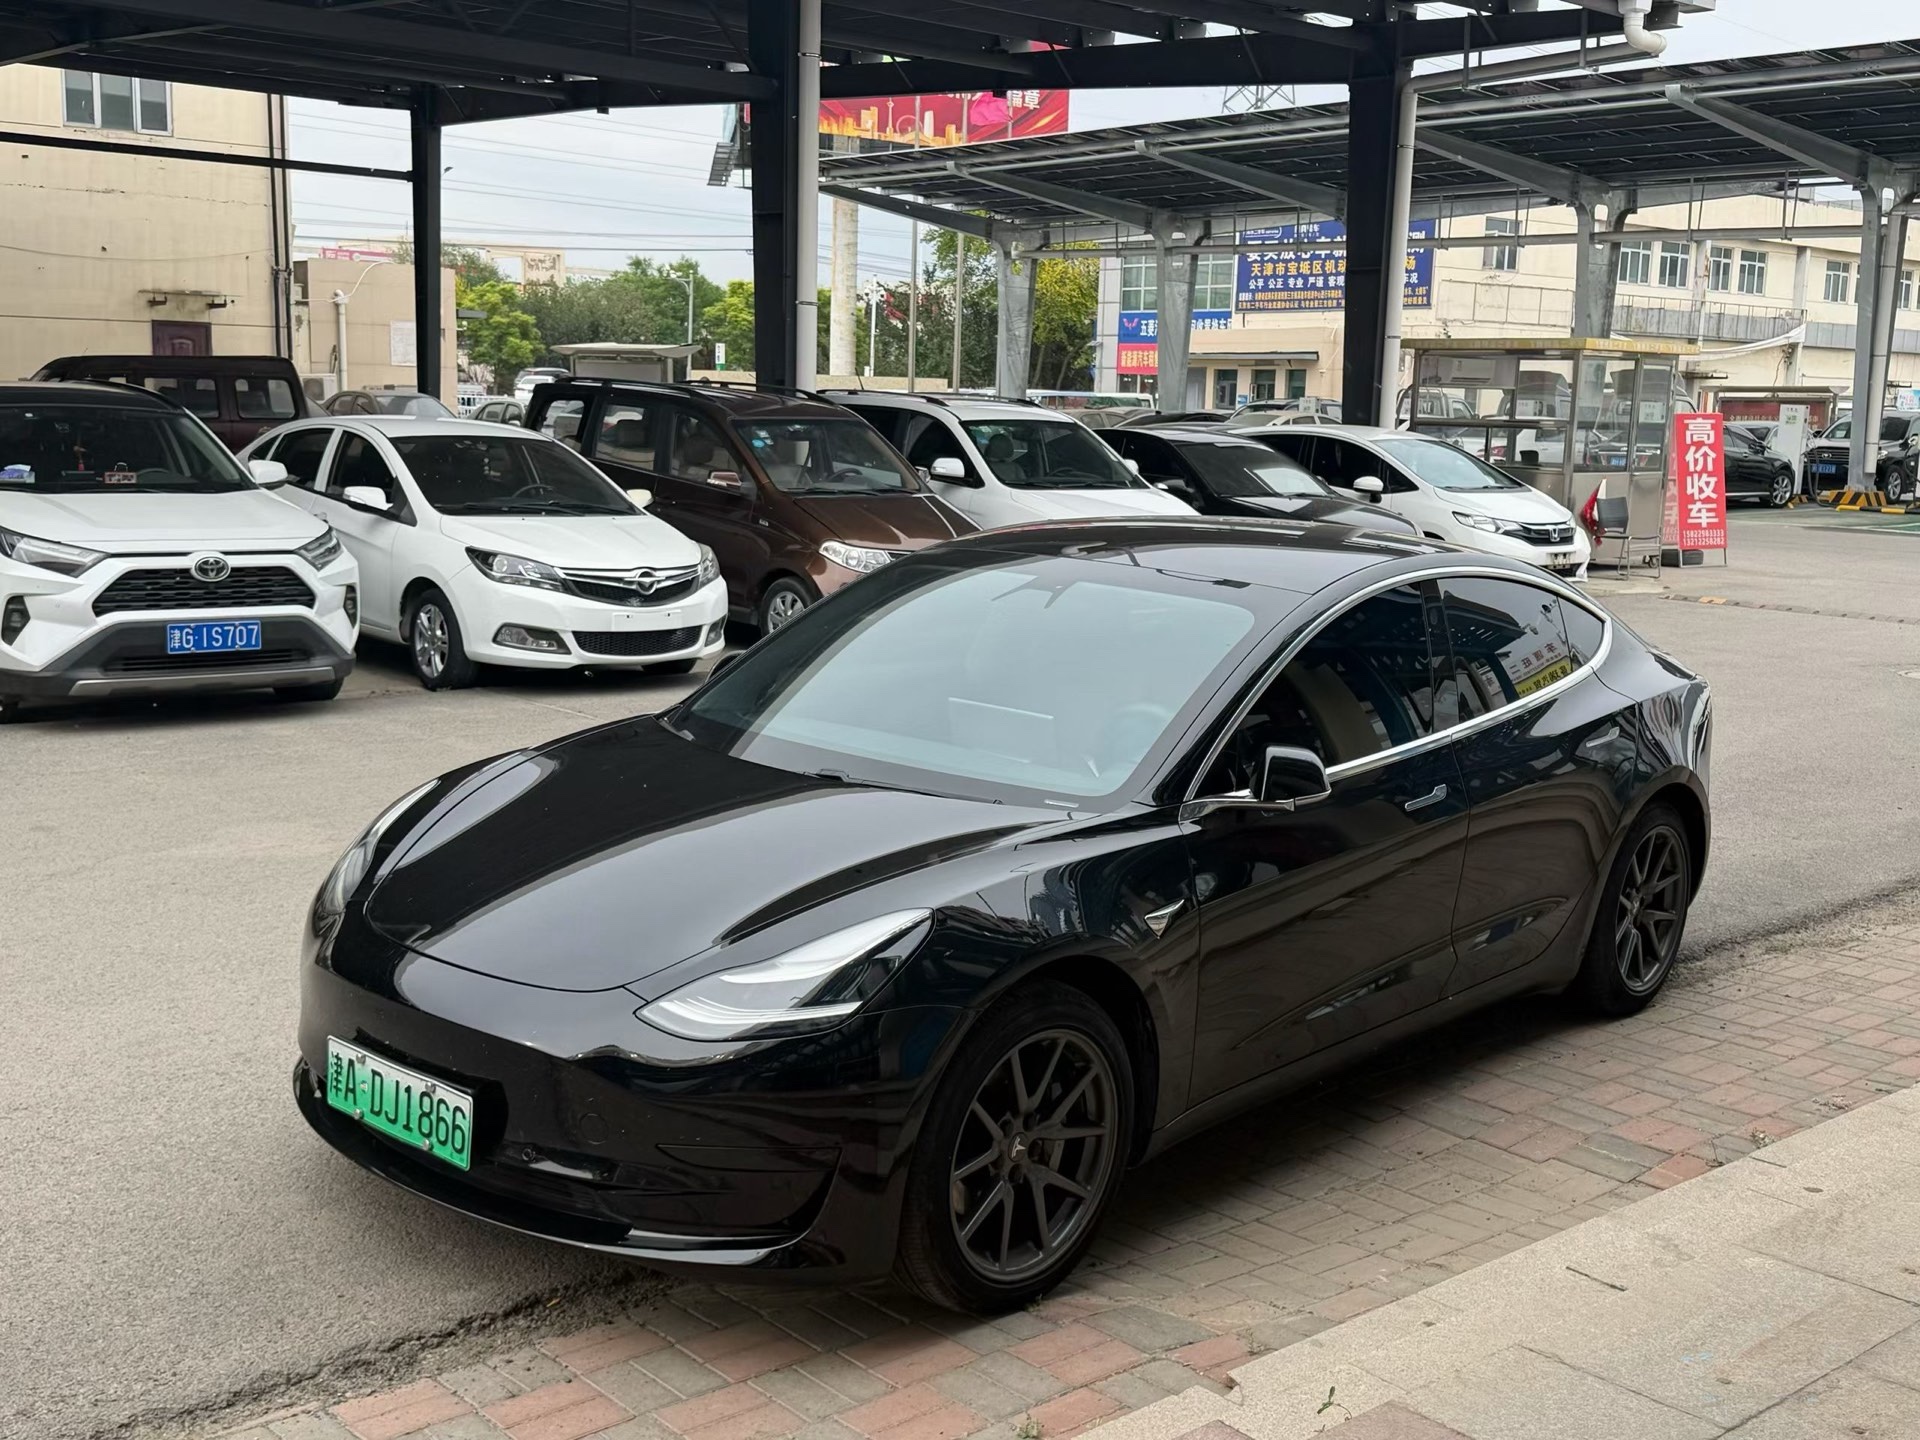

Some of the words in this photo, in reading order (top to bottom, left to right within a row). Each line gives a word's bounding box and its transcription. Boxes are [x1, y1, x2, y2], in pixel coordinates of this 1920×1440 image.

[1248, 278, 1264, 289] 公平
[1268, 278, 1284, 289] 公正
[1288, 277, 1304, 288] 专业
[1307, 276, 1324, 288] 严谨
[1683, 417, 1719, 528] 高价收车
